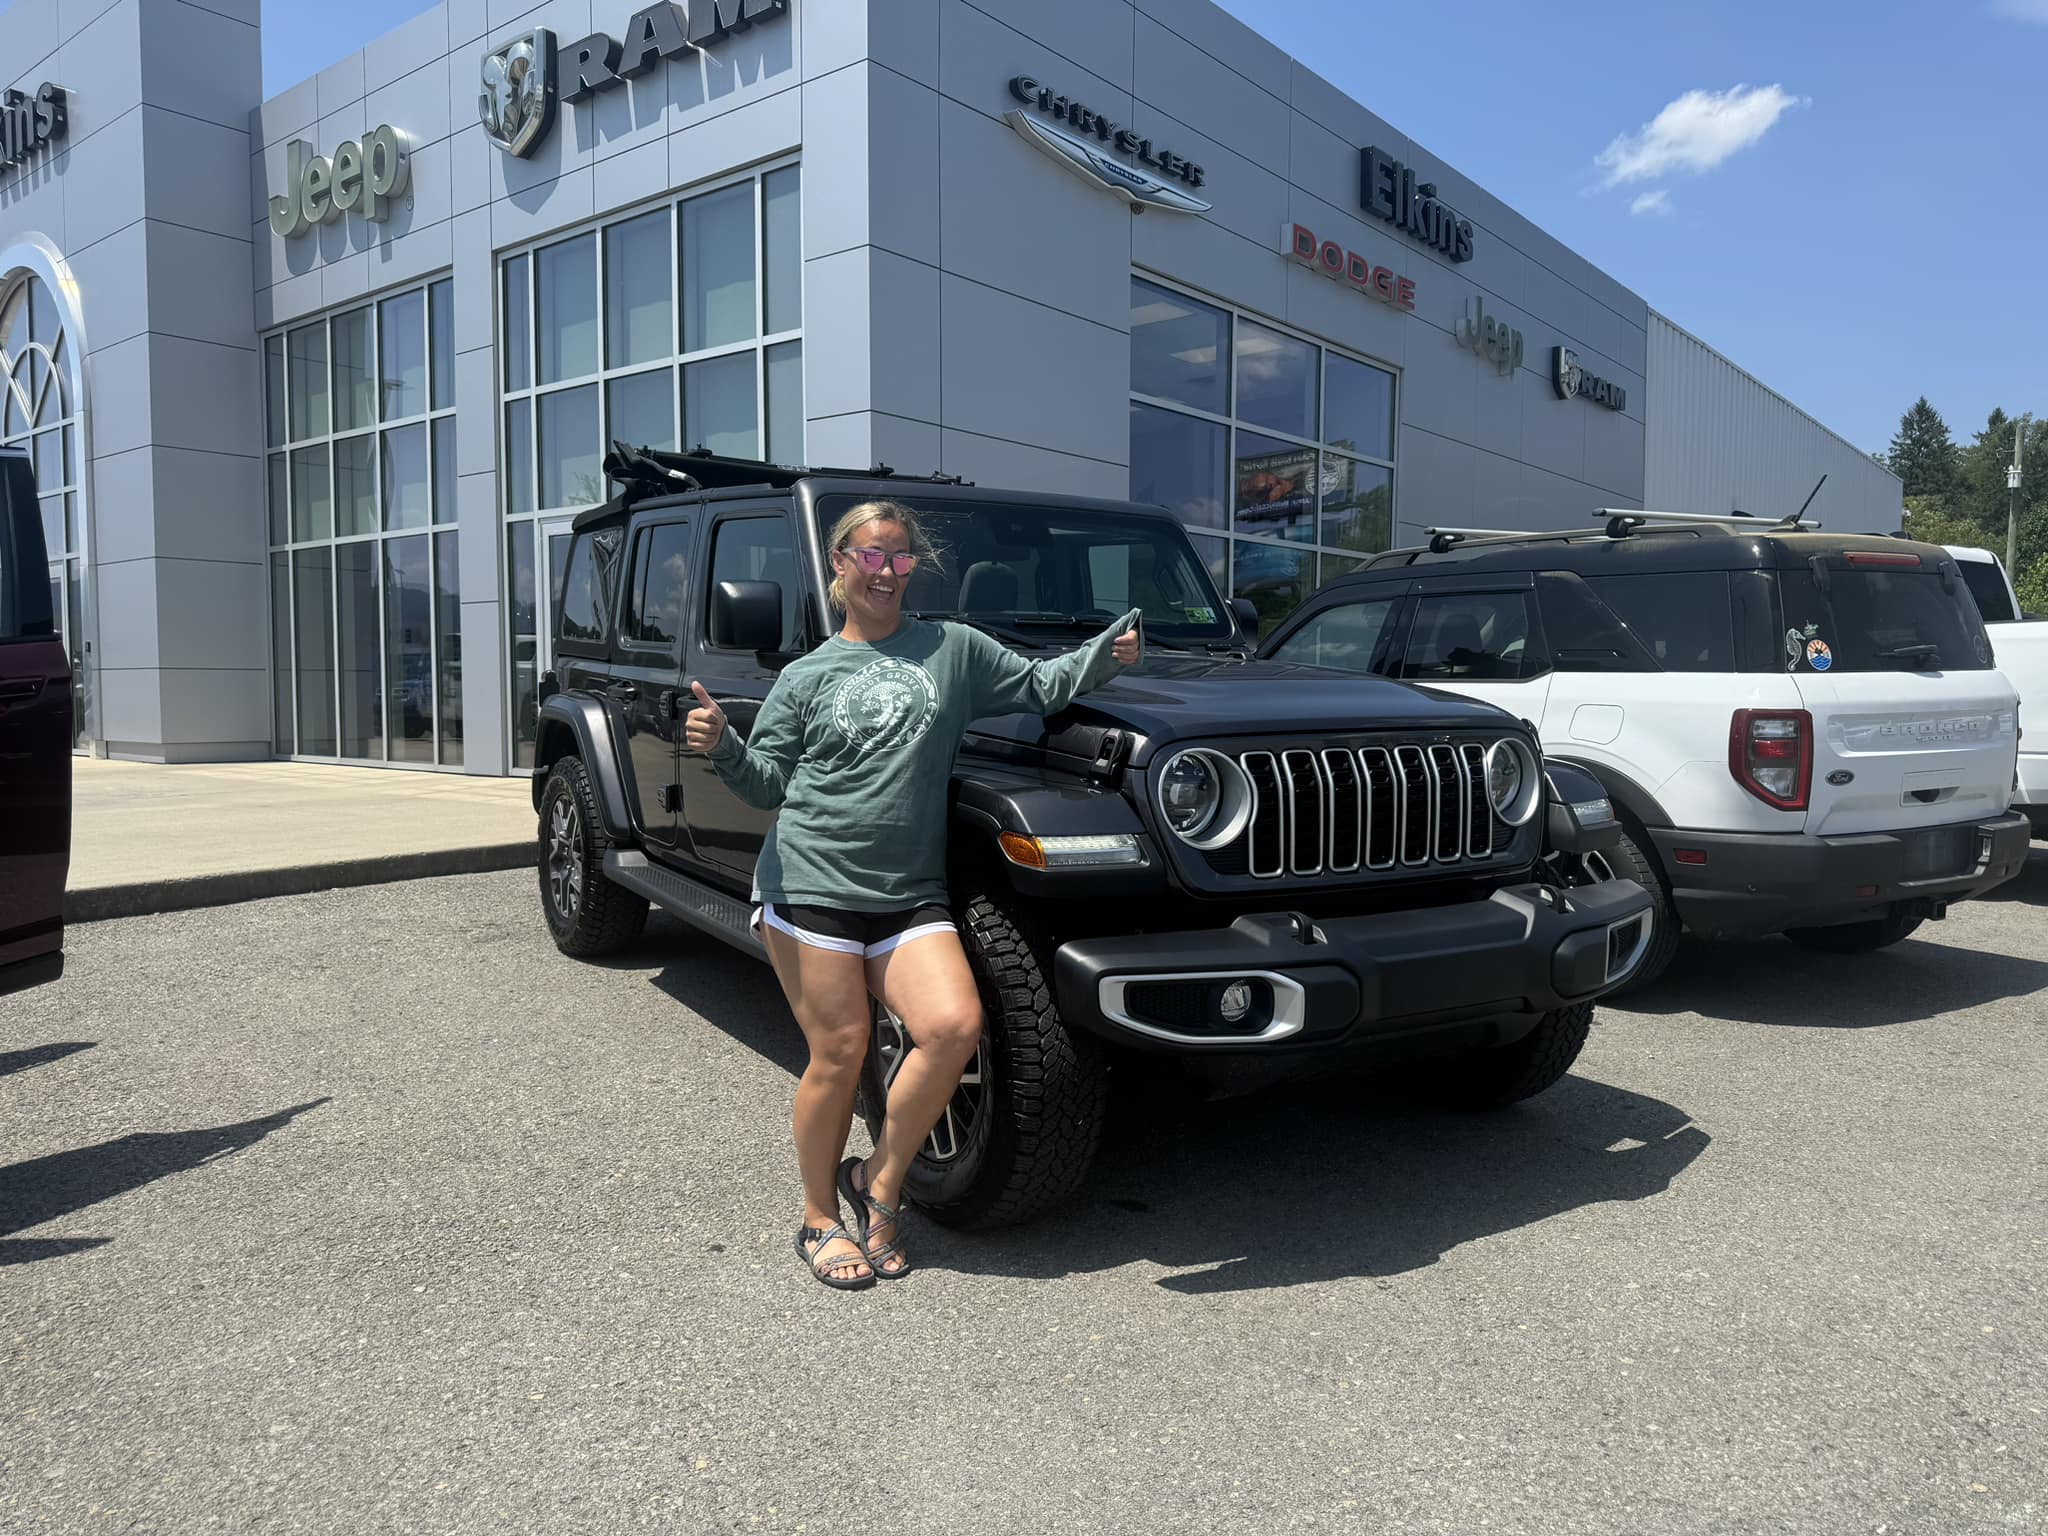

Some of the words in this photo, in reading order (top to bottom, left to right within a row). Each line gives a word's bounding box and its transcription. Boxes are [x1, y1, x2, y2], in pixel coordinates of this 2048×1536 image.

[0, 82, 68, 169] ins
[1009, 75, 1205, 187] CHRYSLER
[269, 124, 410, 238] Jeep
[1360, 146, 1474, 263] Elkins
[1283, 222, 1416, 311] DODGE
[1455, 295, 1524, 376] Jeep
[1579, 369, 1626, 411] RAM
[852, 675, 881, 701] SHADY
[886, 671, 920, 691] GROVE
